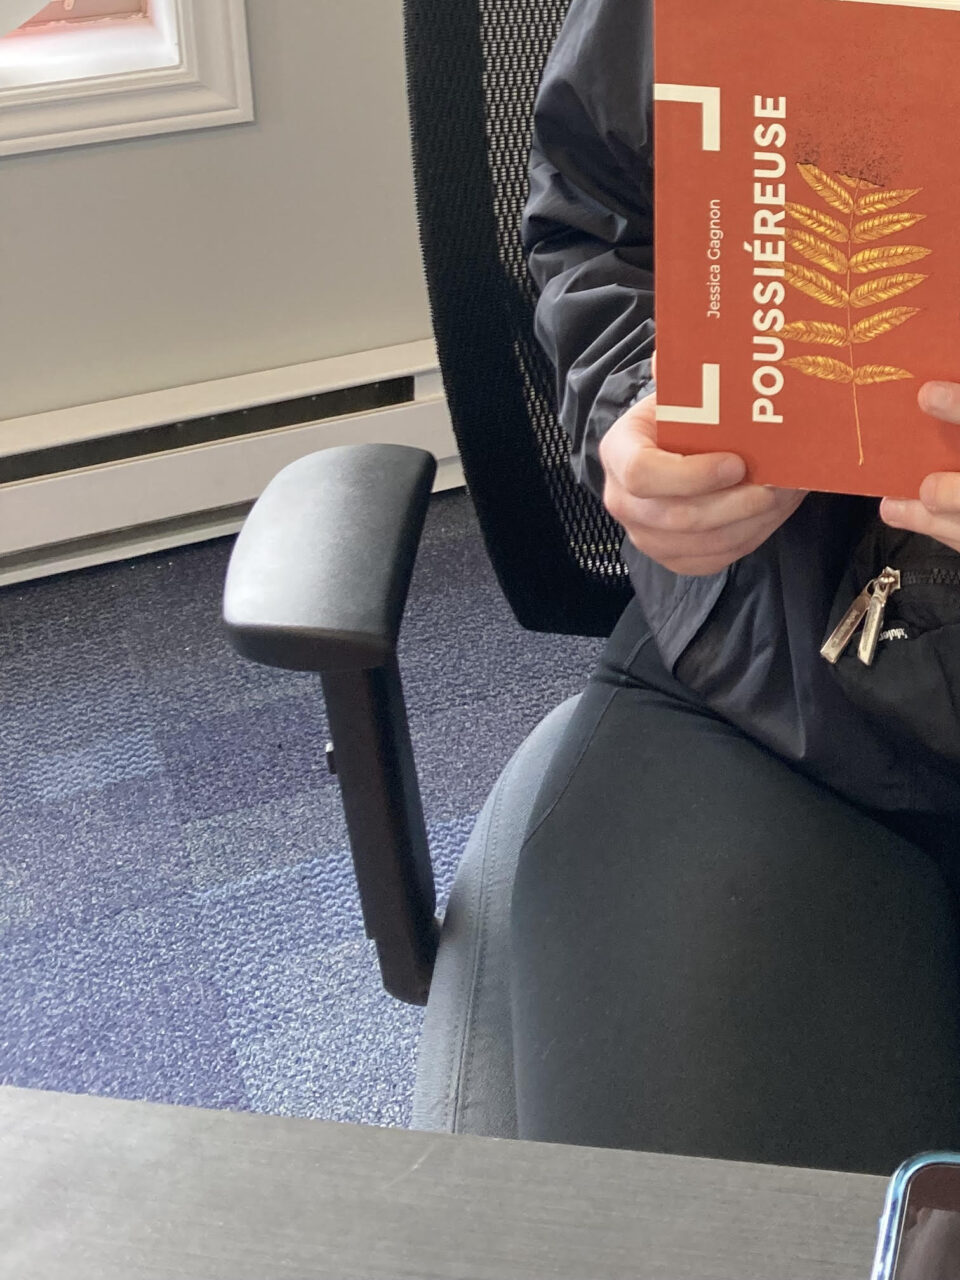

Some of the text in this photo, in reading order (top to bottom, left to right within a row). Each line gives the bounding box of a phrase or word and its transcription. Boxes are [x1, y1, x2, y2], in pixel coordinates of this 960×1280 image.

[706, 198, 724, 319] Jessica Gagnon
[744, 94, 787, 424] POUSSIÉREUSE
